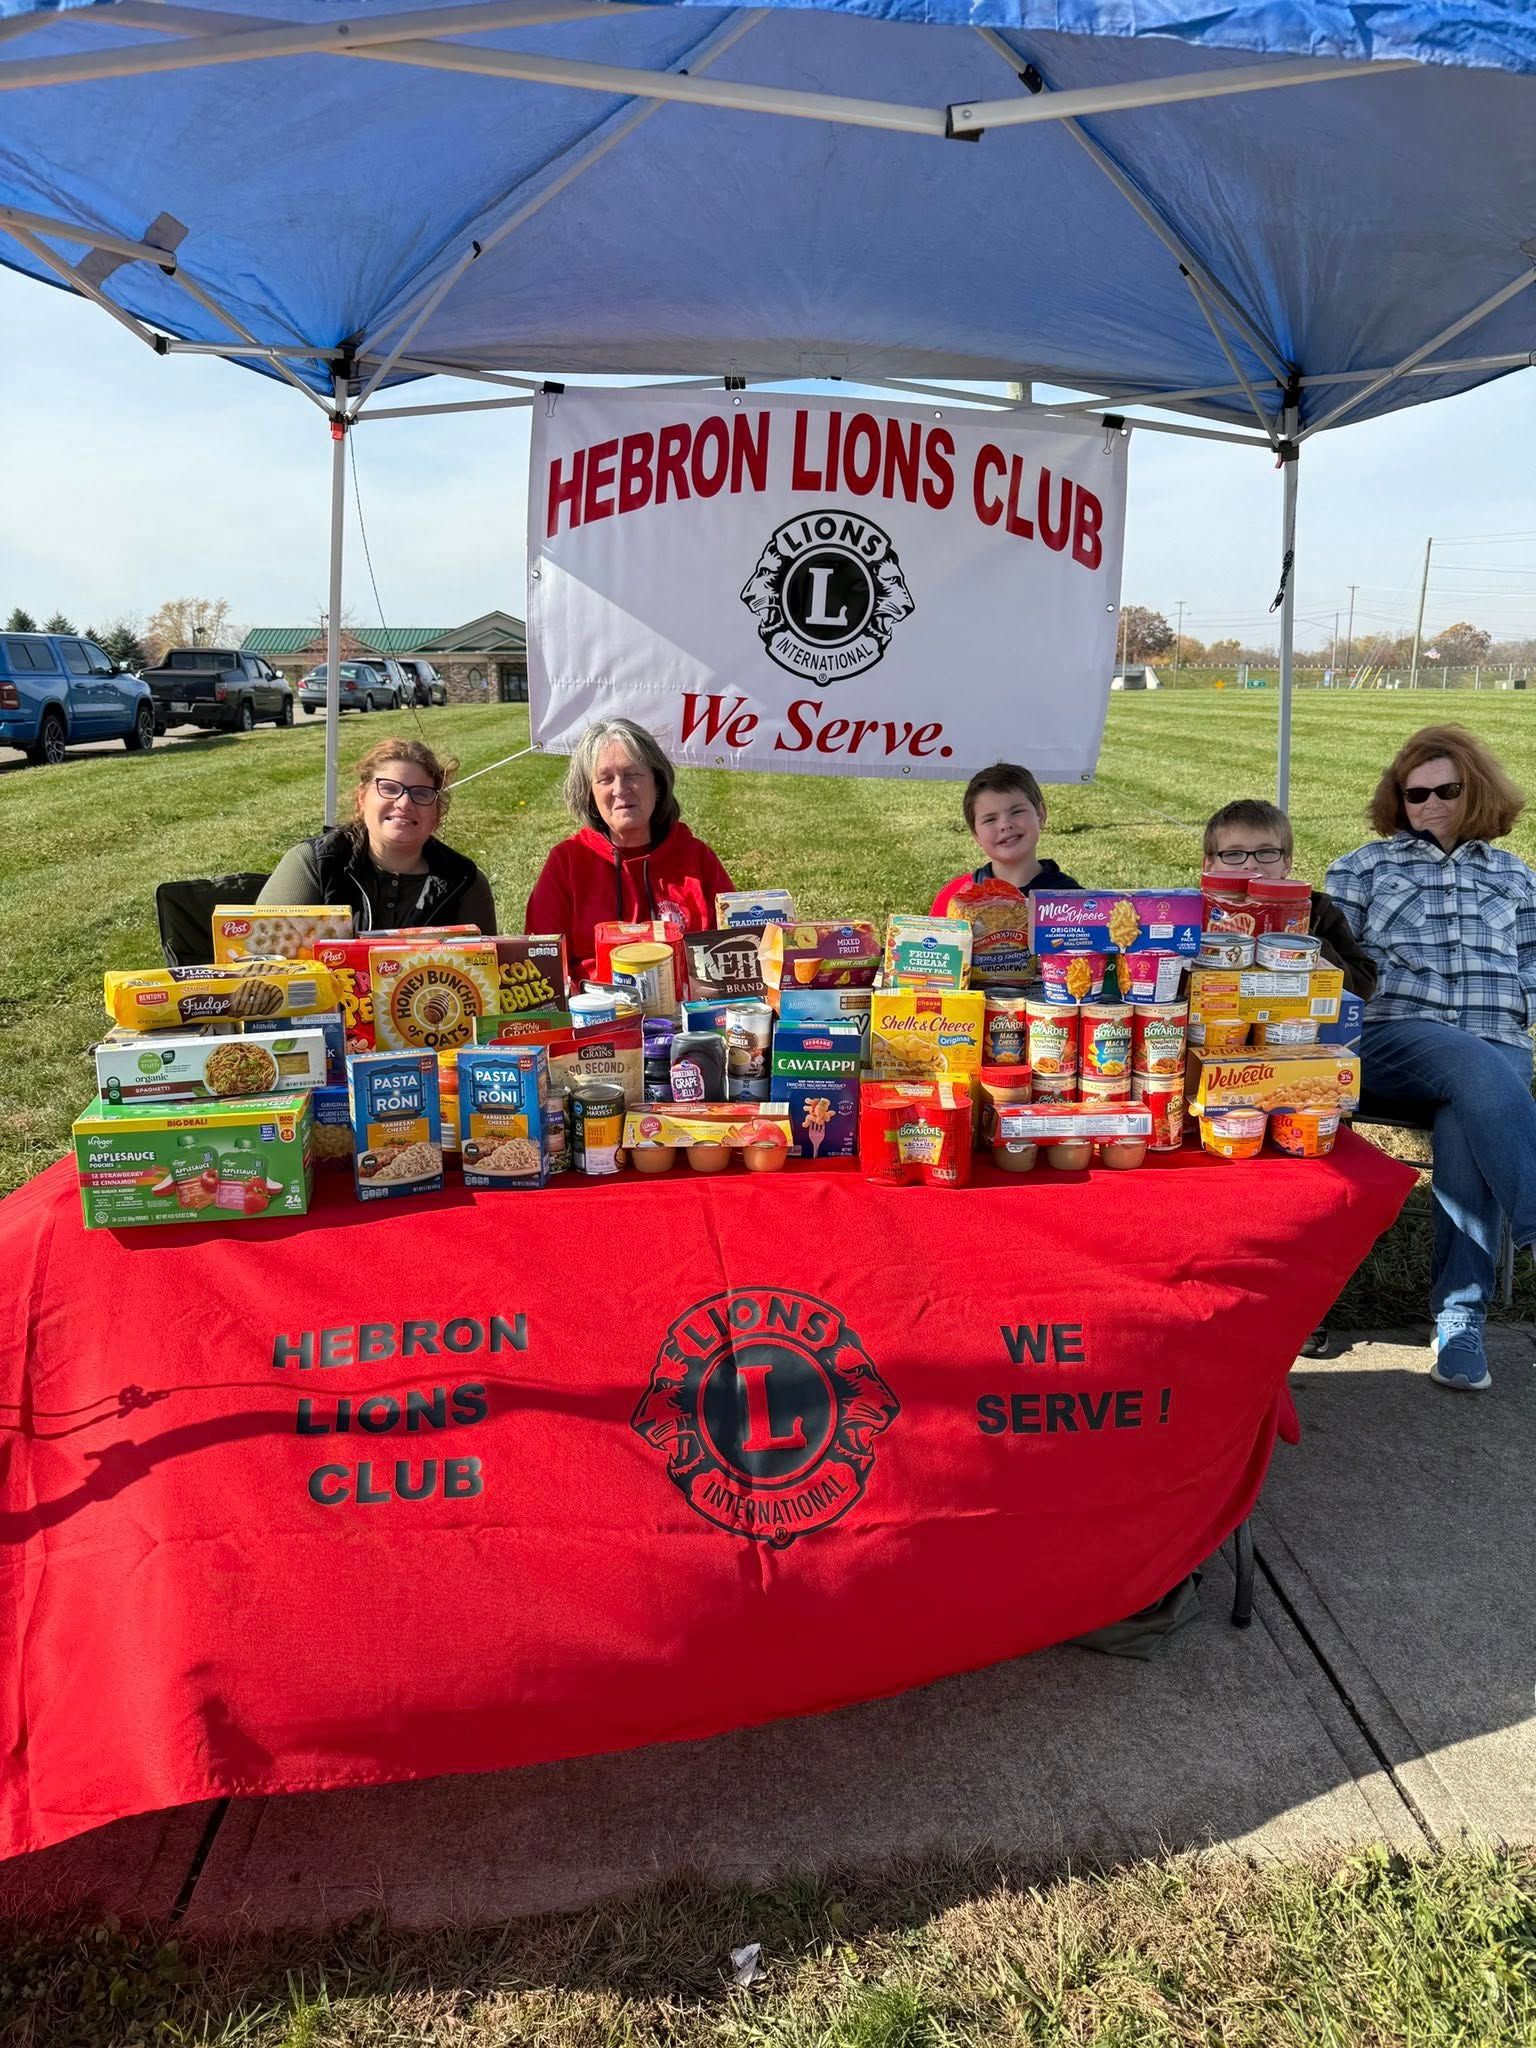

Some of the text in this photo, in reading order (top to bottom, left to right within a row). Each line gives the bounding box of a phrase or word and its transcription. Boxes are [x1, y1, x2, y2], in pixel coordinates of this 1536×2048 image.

[546, 409, 1104, 571] HEBRON LIONS CLUB
[781, 515, 885, 560] LIONS
[804, 567, 849, 627] L
[775, 636, 874, 673] INTERNATIONAL
[681, 692, 954, 758] We Serve.
[1038, 902, 1070, 922] Mac
[1068, 909, 1107, 921] Cheese
[223, 921, 247, 936] Post
[729, 917, 786, 928] TRADITIONAL
[991, 931, 1023, 941] Chicken
[1182, 928, 1192, 937] 4
[839, 946, 860, 954] FRUIT
[909, 951, 950, 960] FRUIT &
[322, 950, 344, 964] Post
[909, 958, 948, 968] CREAM
[377, 962, 399, 975] Post
[931, 967, 953, 975] PACK
[982, 964, 1021, 972] Maruchan
[726, 983, 764, 994] BRAND
[138, 992, 168, 1003] BENTON'S
[398, 972, 426, 1019] HONEY
[428, 971, 477, 1018] BUNCHES
[181, 997, 231, 1016] Fudge
[1347, 1006, 1359, 1021] 5
[252, 1022, 278, 1030] Millville
[880, 1015, 976, 1033] Shells & Cheese
[990, 1021, 1024, 1031] BOYARDE
[408, 1023, 470, 1048] OF OATS
[1030, 1027, 1068, 1037] BOYARDEE
[1093, 1026, 1132, 1038] BOYARDEE
[1144, 1026, 1184, 1037] BOYARDEE
[939, 1037, 971, 1046] Original
[580, 1049, 613, 1060] GRAINS
[1103, 1046, 1125, 1054] CHEESE
[585, 1061, 625, 1074] SECOND
[777, 1058, 855, 1072] CAVATAPPI
[135, 1072, 169, 1084] organic
[373, 1075, 418, 1090] PASTA
[476, 1070, 517, 1083] PASTA
[1208, 1063, 1275, 1091] Velveeta
[675, 1077, 698, 1089] GRAPE
[135, 1086, 172, 1094] SPAGHETTI
[681, 1088, 695, 1098] JELLY
[478, 1090, 517, 1103] RONI
[376, 1095, 418, 1112] RONI
[381, 1120, 415, 1128] PARMESAN
[587, 1127, 606, 1136] SWEET
[900, 1127, 940, 1136] BOYARDEE
[88, 1136, 113, 1149] Kroger
[89, 1151, 155, 1162] APPLESAUCE
[175, 1163, 210, 1174] APPLESAUCE
[99, 1171, 144, 1179] STRAWBERRY
[285, 1194, 302, 1204] 24
[682, 1295, 838, 1356] LIONS
[273, 1313, 529, 1370] HEBRON
[999, 1324, 1086, 1364] WE
[295, 1383, 489, 1437] LIONS
[738, 1364, 807, 1452] L
[976, 1393, 1144, 1436] SERVE
[307, 1456, 484, 1505] CLUB
[699, 1474, 850, 1530] INTERNATIONAL
